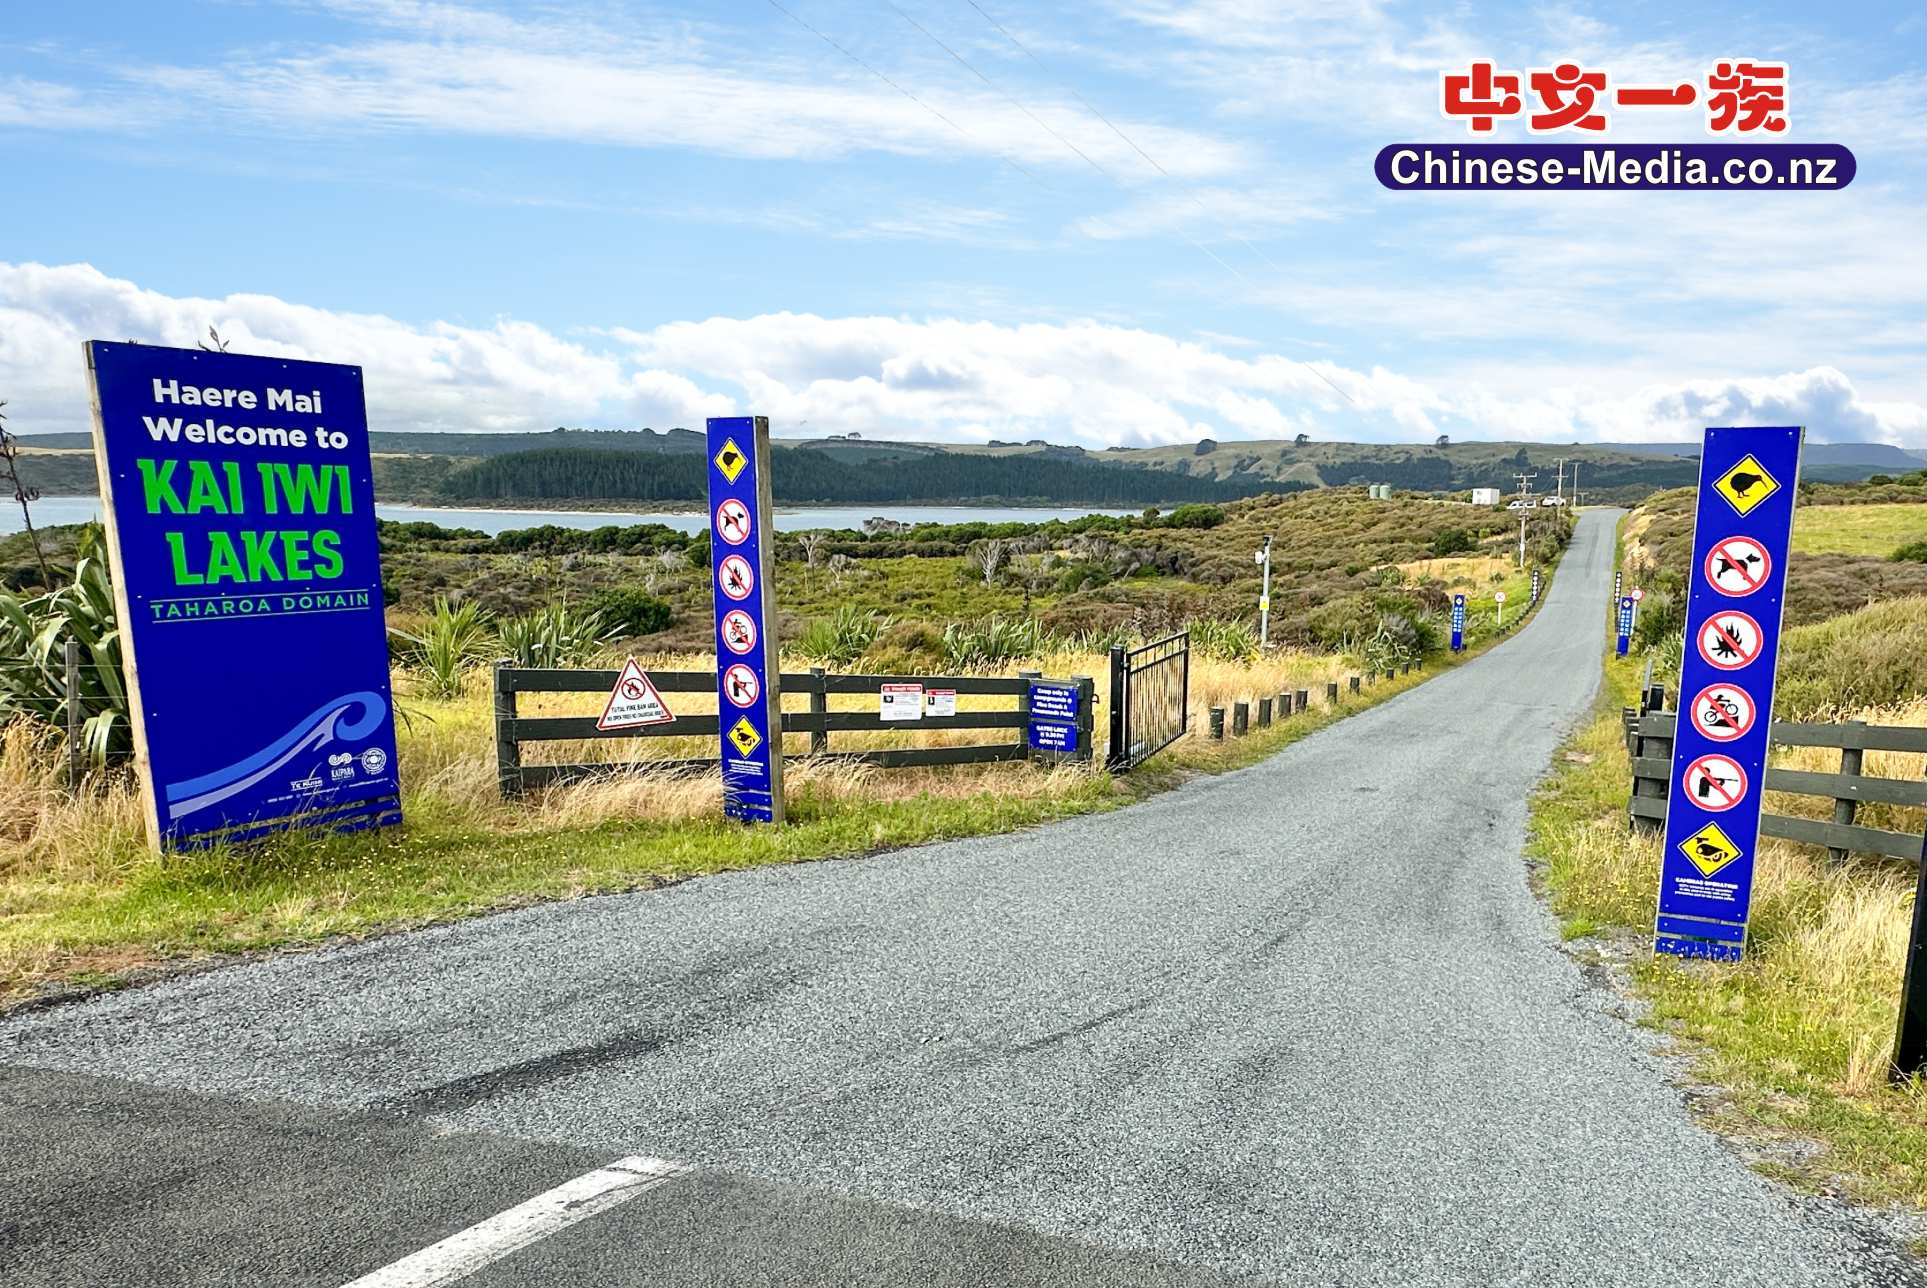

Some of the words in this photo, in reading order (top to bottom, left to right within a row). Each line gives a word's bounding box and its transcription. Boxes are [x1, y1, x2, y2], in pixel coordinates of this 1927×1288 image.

[152, 378, 258, 409] Haere
[266, 387, 323, 414] Mai
[142, 415, 308, 448] Welcome
[315, 426, 349, 450] to
[136, 458, 245, 514] KAI
[256, 462, 354, 514] IWI
[164, 529, 344, 586] LAKES
[150, 598, 271, 619] TAHAROA
[282, 593, 370, 611] DOMAIN
